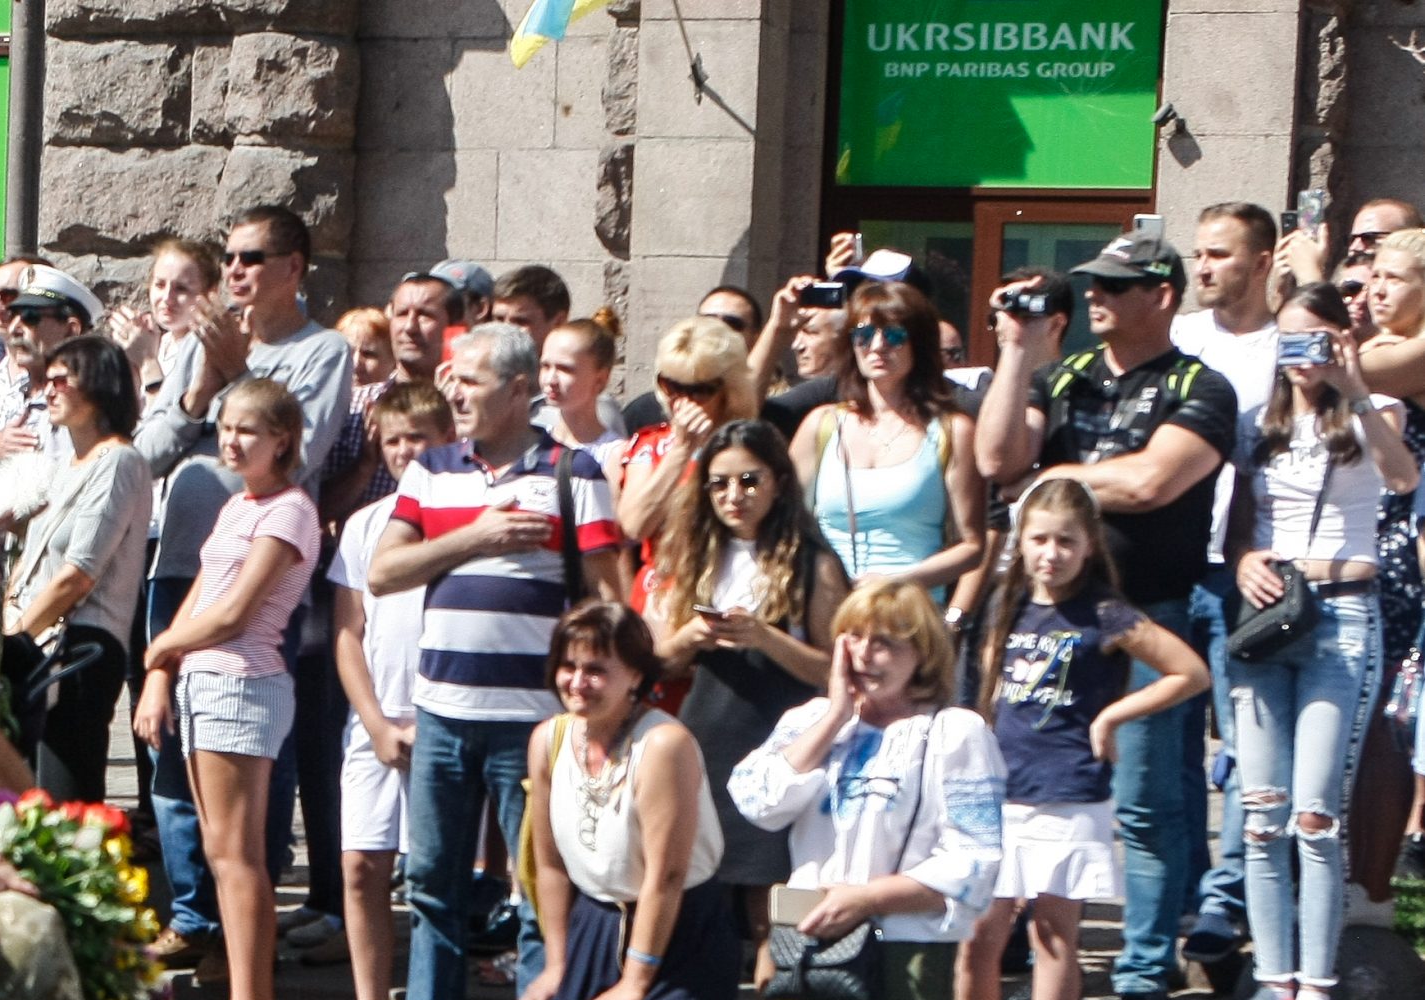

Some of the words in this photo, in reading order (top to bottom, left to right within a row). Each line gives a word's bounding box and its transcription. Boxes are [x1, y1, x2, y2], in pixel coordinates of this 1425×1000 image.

[867, 22, 1136, 51] UKRSIBBANK
[884, 62, 929, 78] BNP
[936, 62, 1030, 78] PARIBAS
[1036, 62, 1116, 78] GROUP
